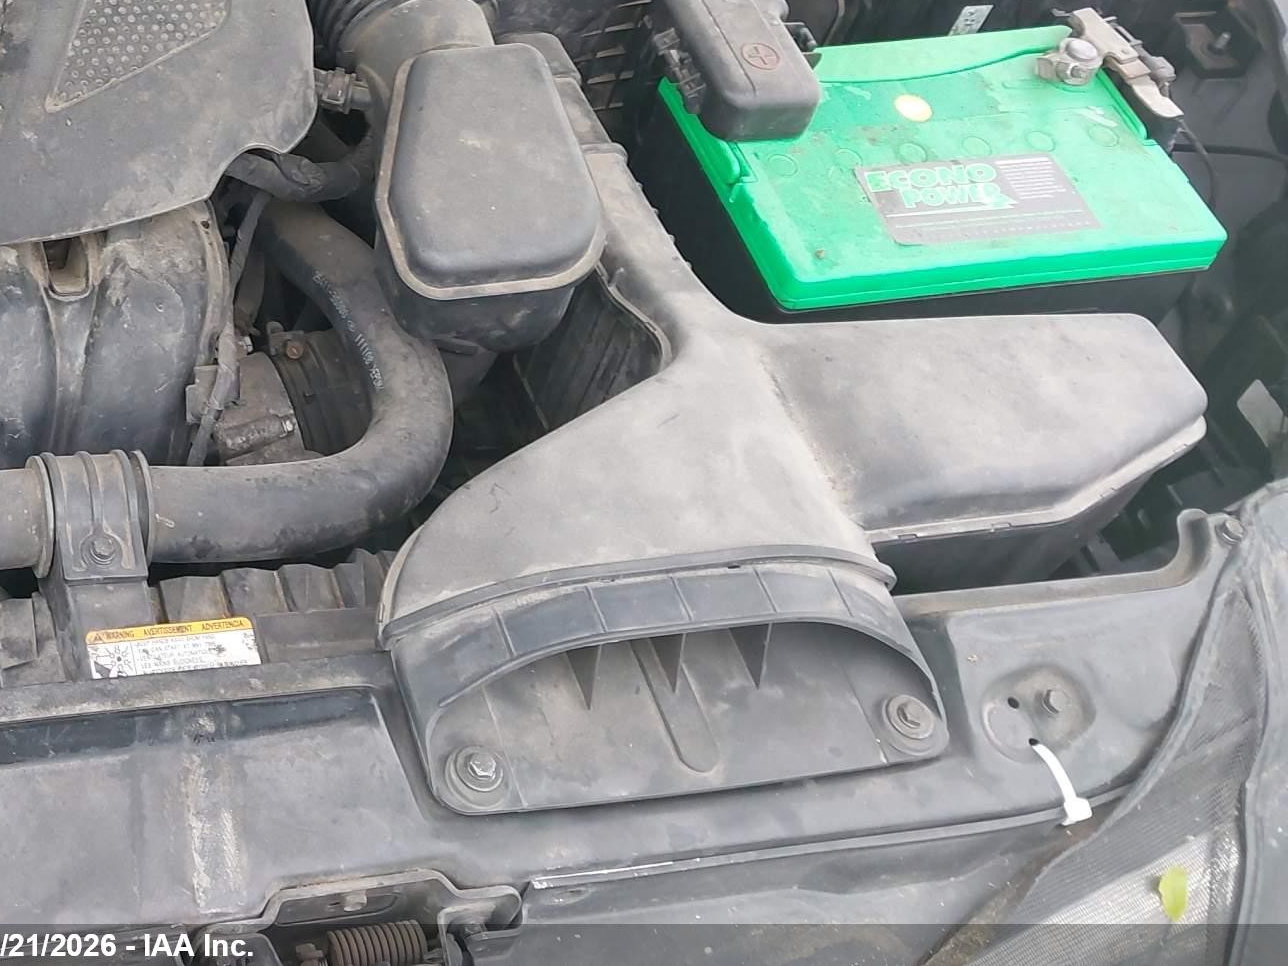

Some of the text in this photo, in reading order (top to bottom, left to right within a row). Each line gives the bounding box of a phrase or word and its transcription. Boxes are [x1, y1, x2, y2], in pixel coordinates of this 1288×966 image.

[864, 163, 997, 192] ECONO
[105, 620, 245, 640] WARNING AVERTISSEMENT ADVERTENCIA
